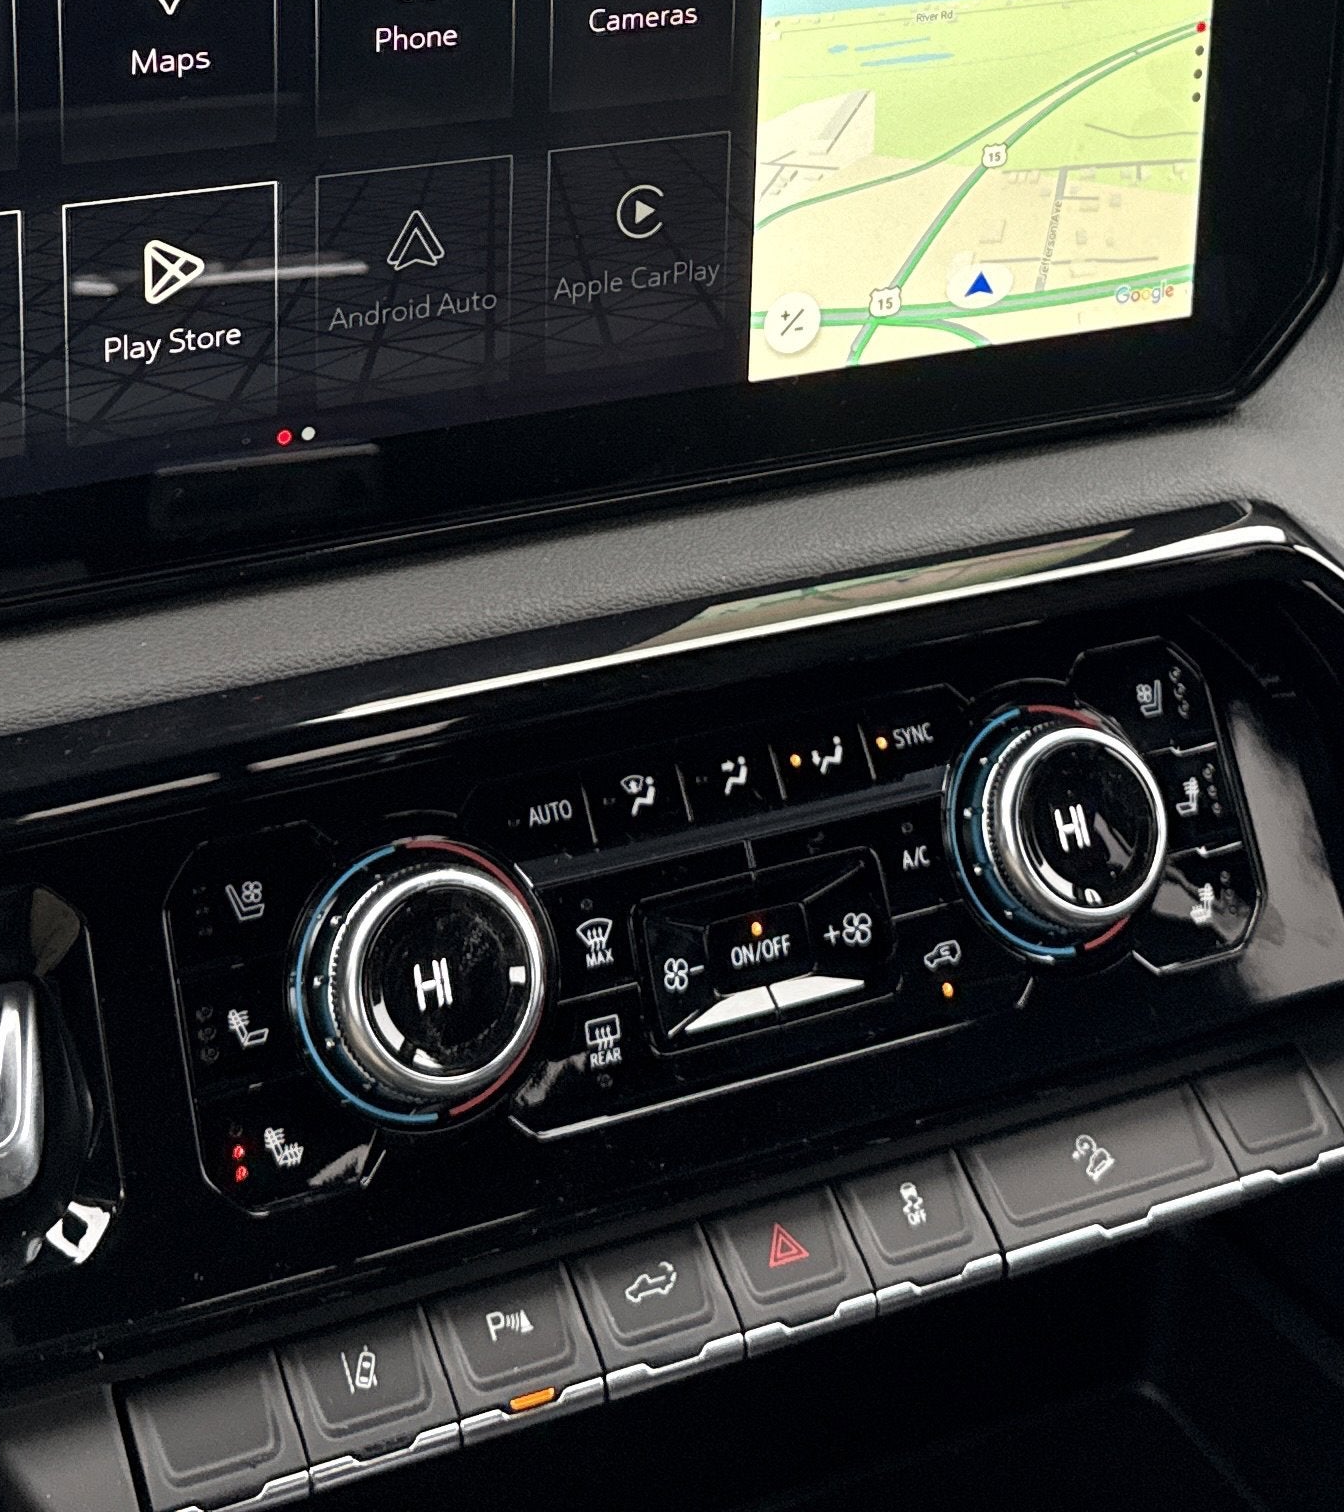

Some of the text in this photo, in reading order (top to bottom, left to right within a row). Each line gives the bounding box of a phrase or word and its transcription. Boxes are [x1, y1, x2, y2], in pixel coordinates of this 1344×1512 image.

[588, 6, 699, 34] Cameras
[915, 10, 953, 23] River Rd
[374, 25, 459, 54] Phone
[130, 48, 212, 78] Maps
[988, 151, 1002, 163] 15
[553, 260, 722, 302] Apple CarPlay
[1115, 281, 1175, 305] Google
[327, 291, 498, 332] Android Auto
[878, 297, 894, 310] 15
[103, 326, 243, 365] Play Store
[892, 722, 934, 749] SYNC
[528, 799, 573, 827] AUTO
[1055, 804, 1092, 852] HI
[902, 845, 931, 871] A/C
[585, 948, 614, 969] MAX
[730, 934, 792, 968] ON/OFF
[413, 957, 453, 1012] HI
[589, 1047, 622, 1068] REAR
[907, 1208, 927, 1225] OFF
